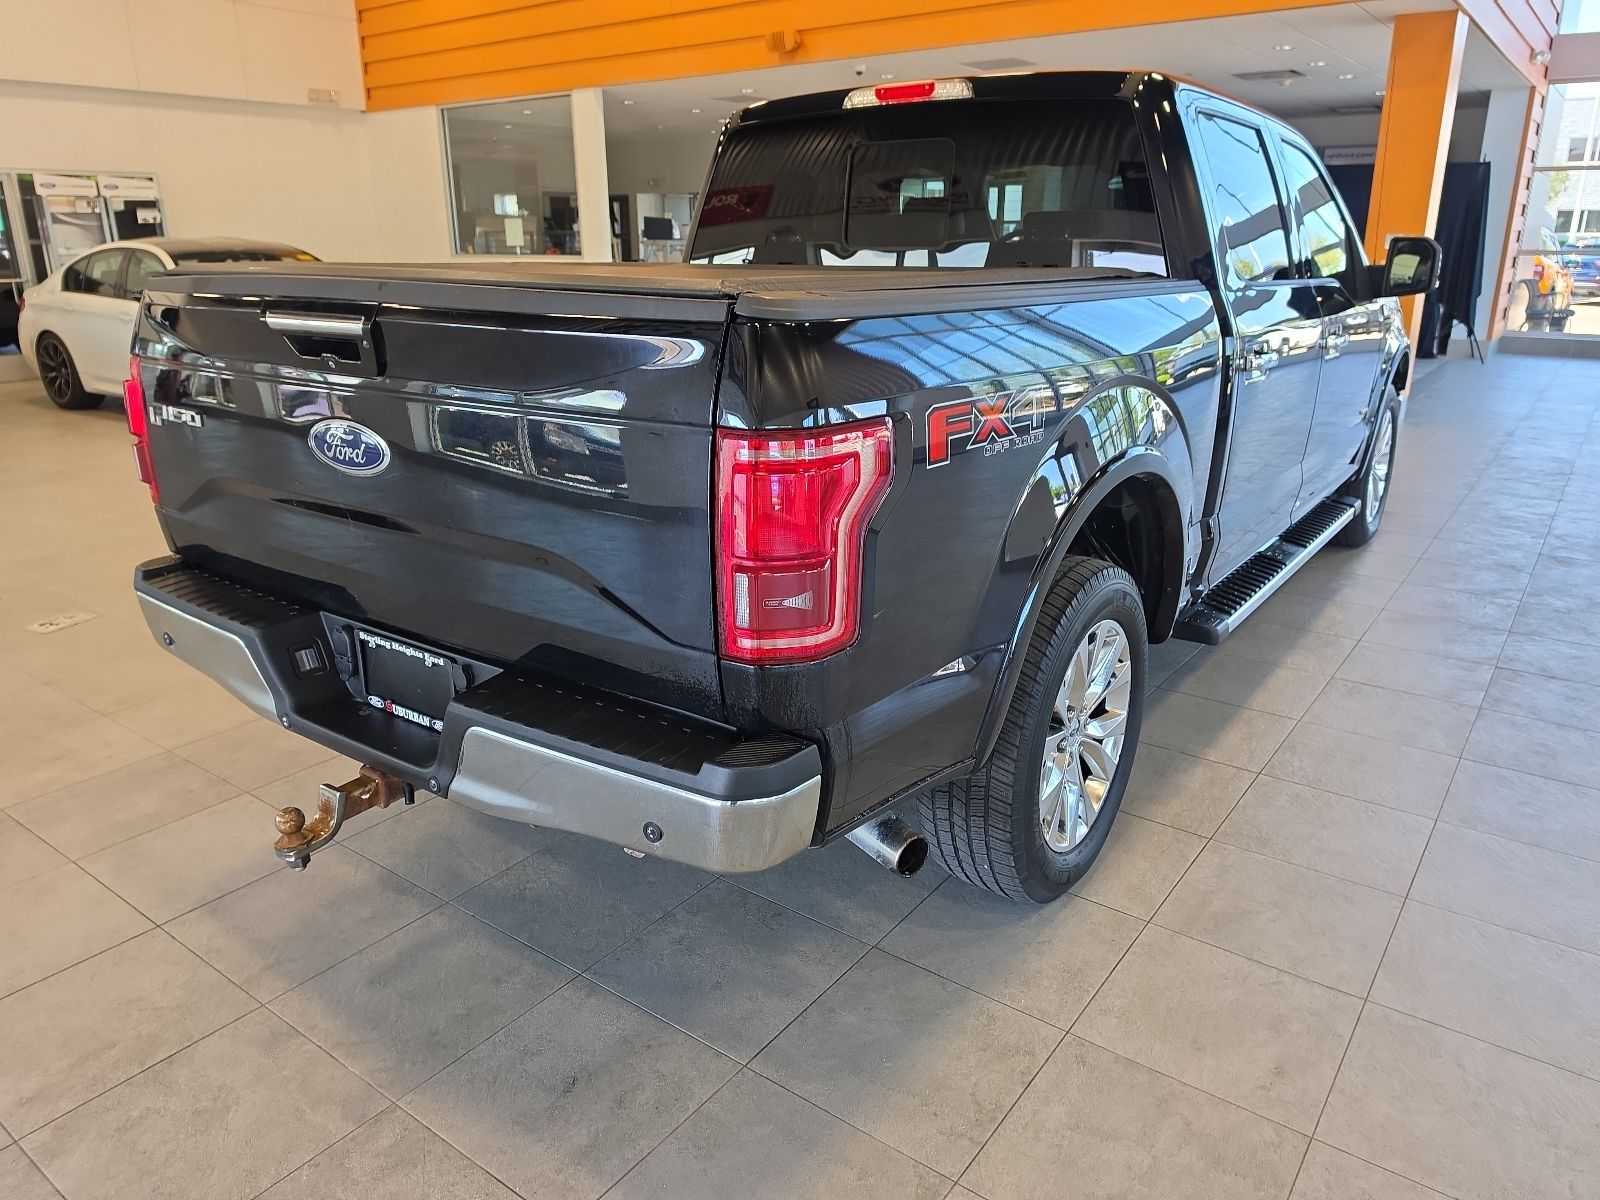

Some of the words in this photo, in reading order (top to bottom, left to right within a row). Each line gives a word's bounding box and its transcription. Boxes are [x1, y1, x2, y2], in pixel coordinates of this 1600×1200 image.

[926, 385, 1046, 469] FX4
[984, 440, 1010, 457] OFF
[1014, 432, 1045, 449] ROAD
[324, 427, 367, 464] Ford
[359, 631, 391, 649] Sterling
[391, 641, 423, 657] Heights
[424, 652, 444, 666] Ford
[385, 699, 430, 727] SUBURBAN
